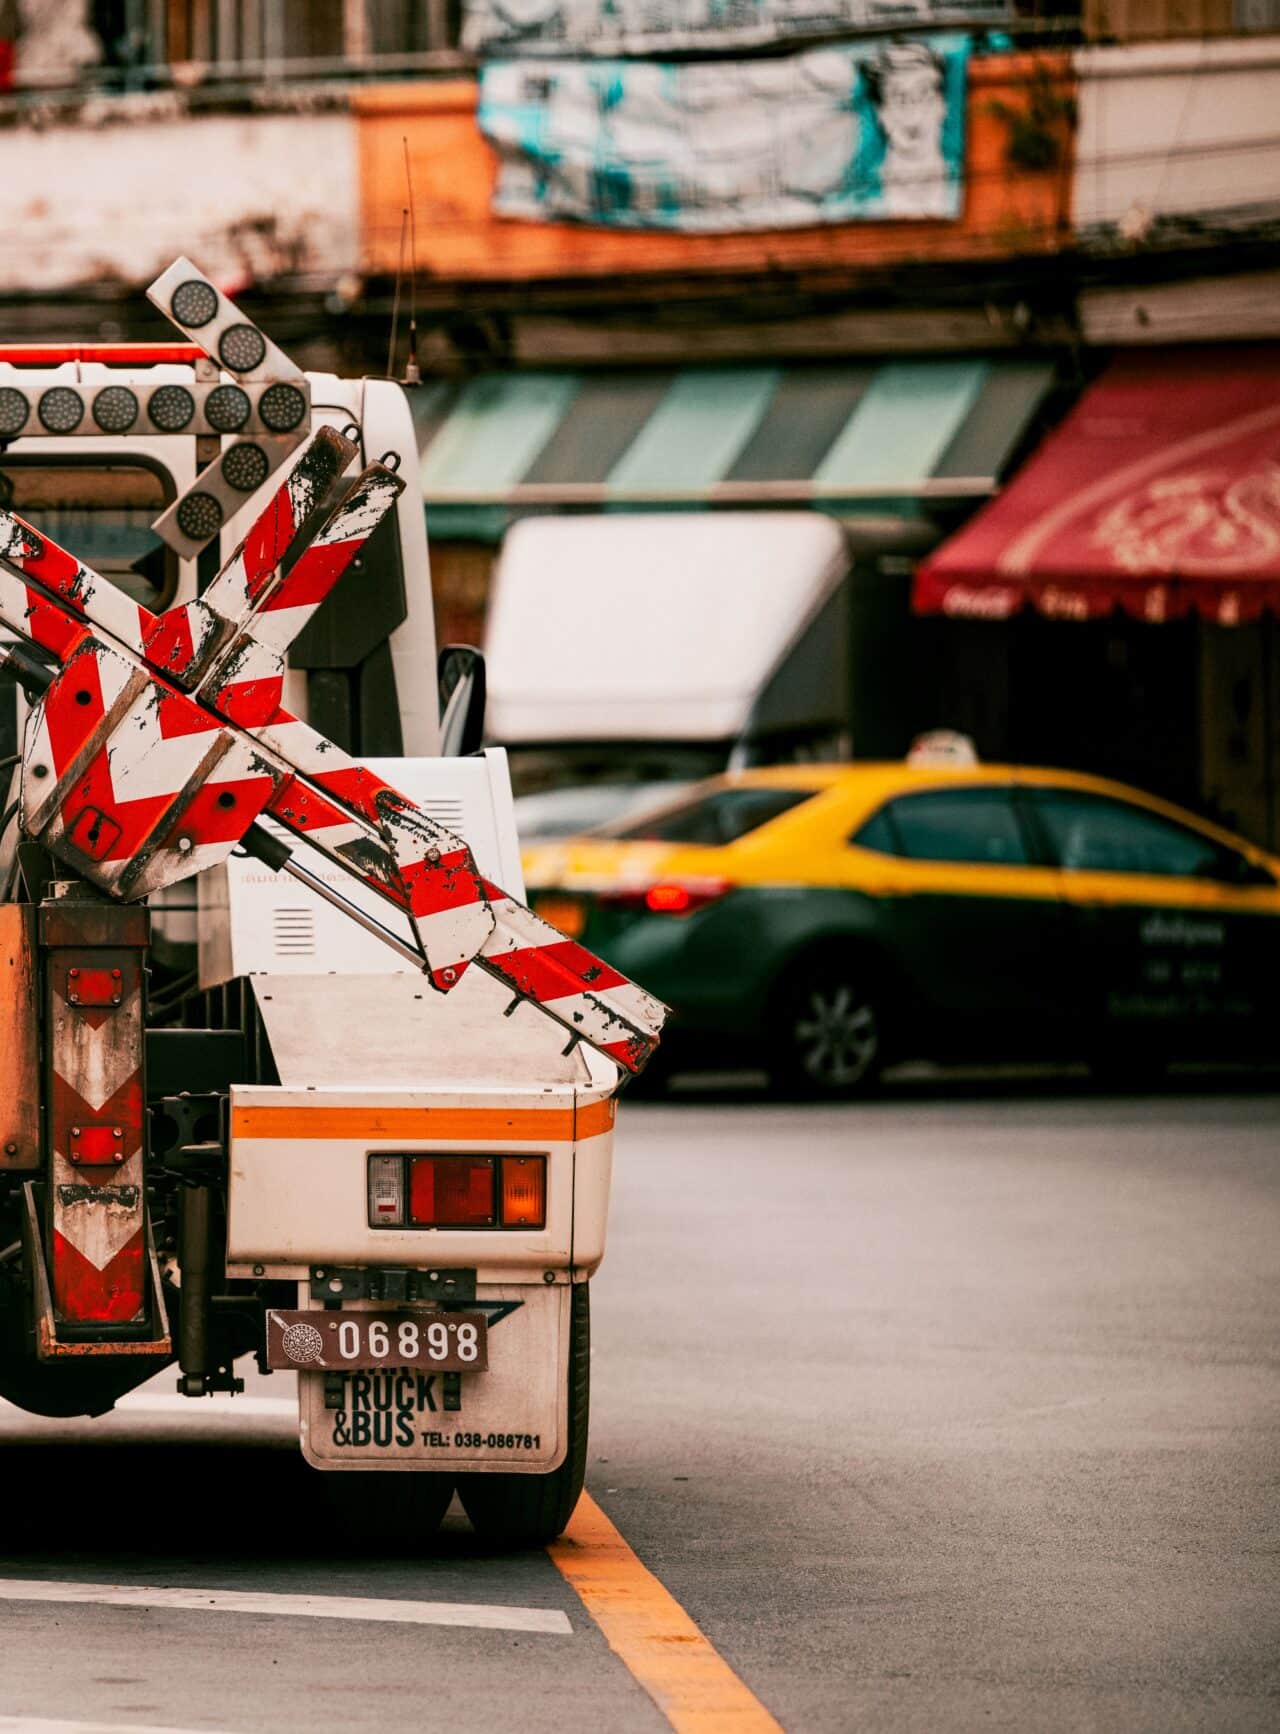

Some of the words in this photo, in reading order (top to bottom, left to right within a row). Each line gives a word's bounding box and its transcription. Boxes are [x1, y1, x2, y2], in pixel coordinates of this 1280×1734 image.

[338, 1320, 479, 1362] 06898
[332, 1411, 416, 1447] &BUS
[420, 1431, 451, 1448] TEL:
[454, 1432, 541, 1449] 038-086781
